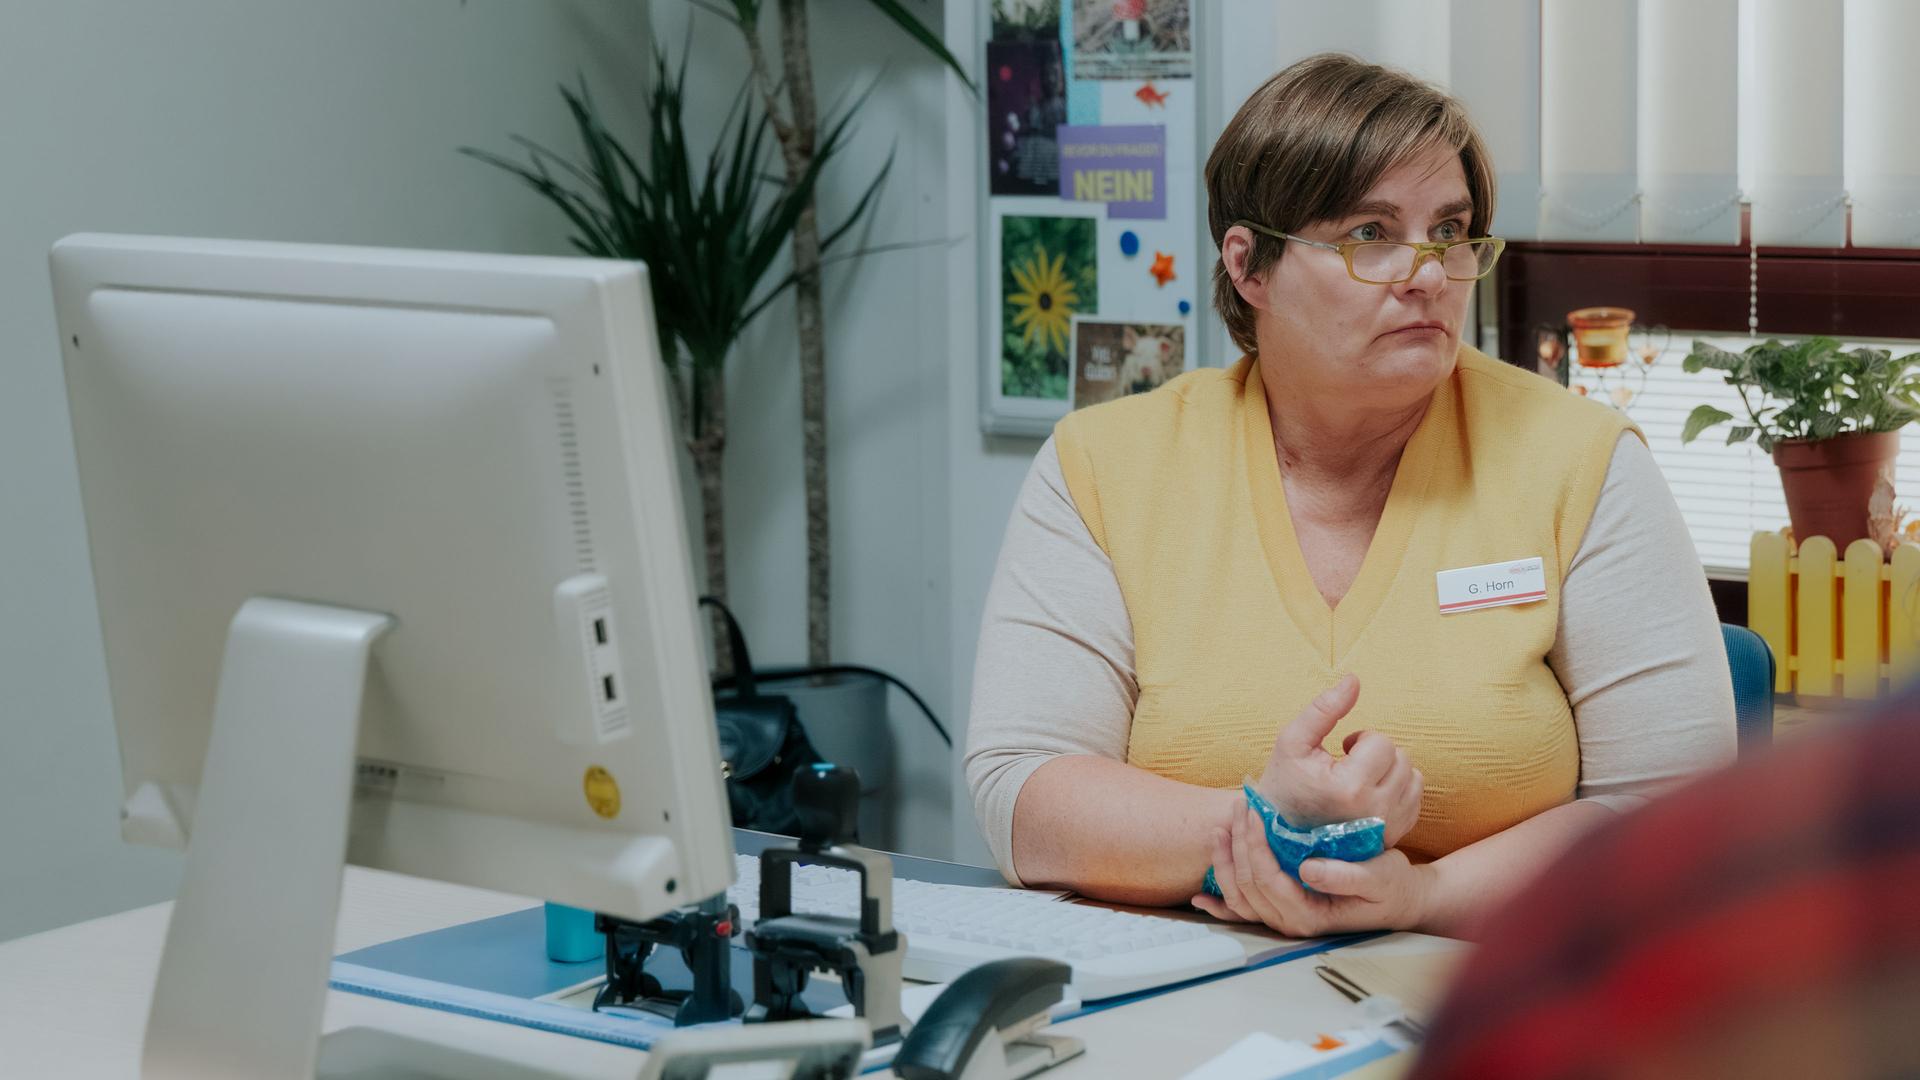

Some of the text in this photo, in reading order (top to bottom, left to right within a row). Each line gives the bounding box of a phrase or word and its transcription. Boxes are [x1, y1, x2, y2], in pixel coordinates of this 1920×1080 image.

[1074, 170, 1153, 202] NEIN!
[1468, 580, 1515, 595] G. Horn
